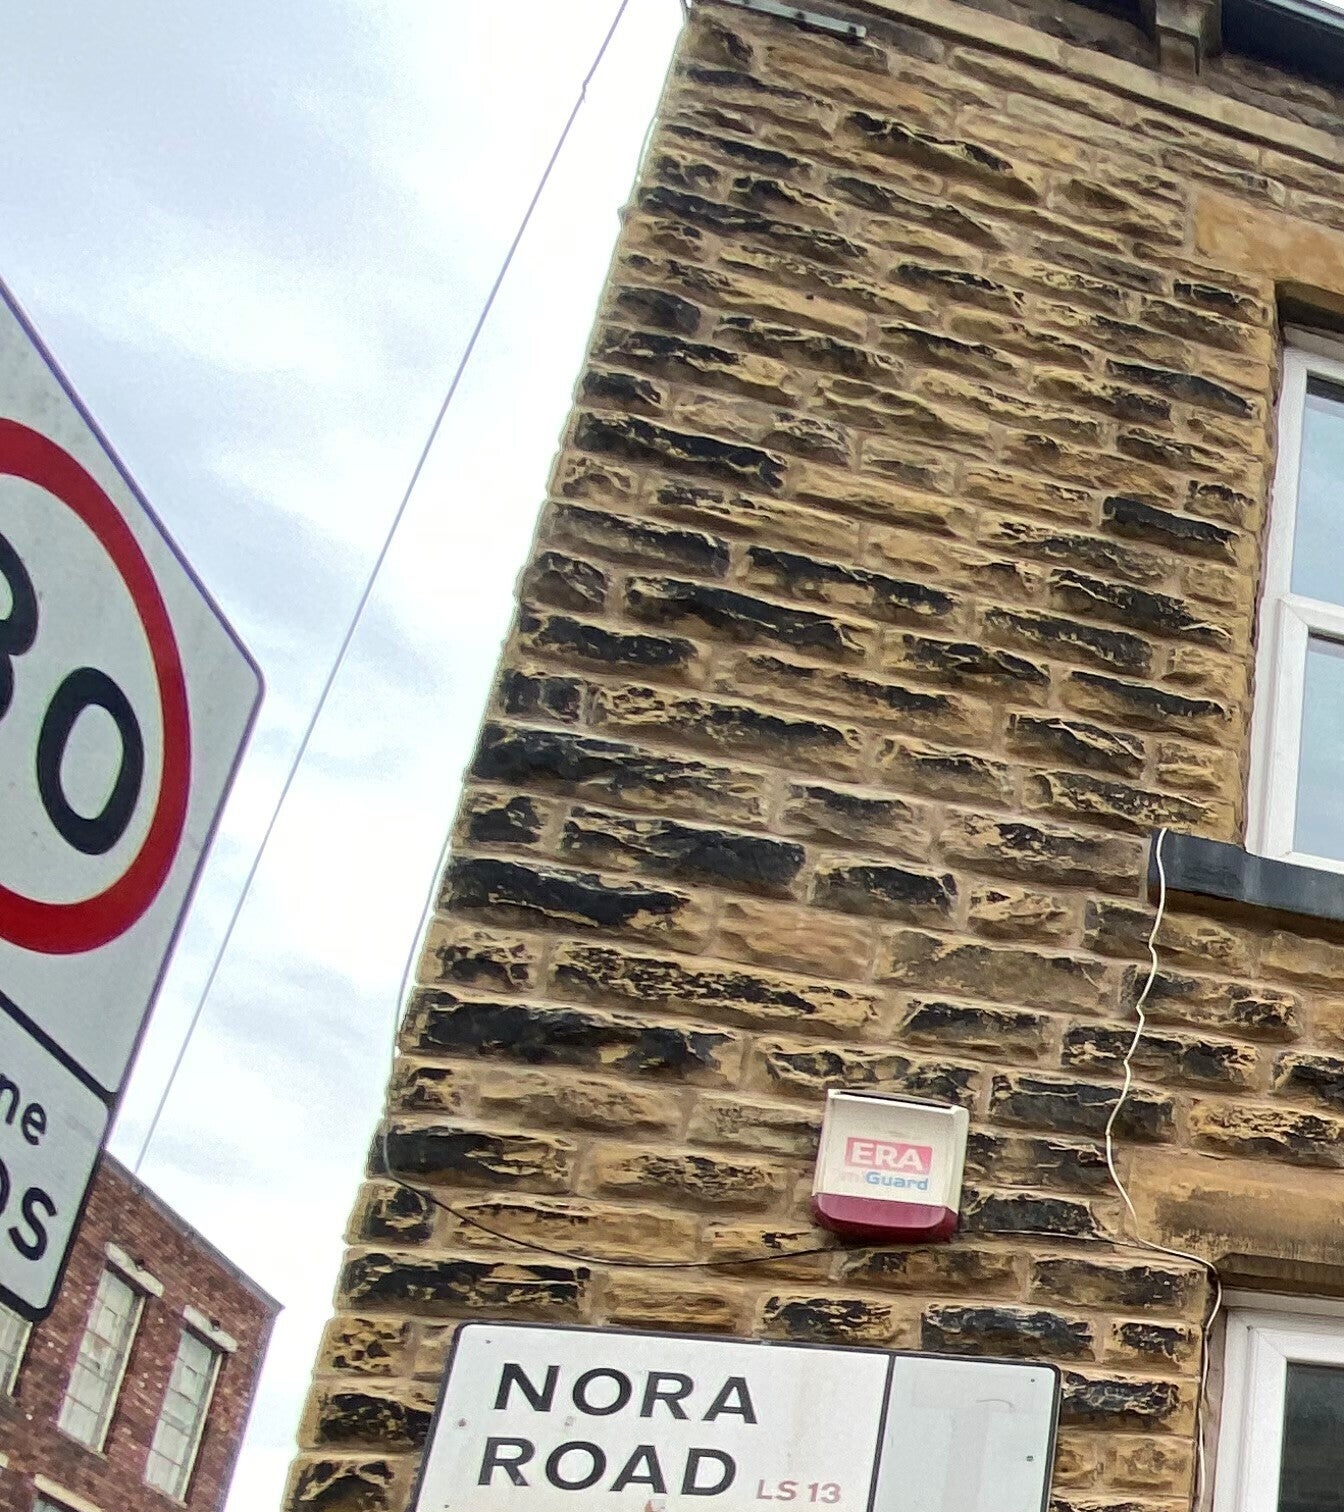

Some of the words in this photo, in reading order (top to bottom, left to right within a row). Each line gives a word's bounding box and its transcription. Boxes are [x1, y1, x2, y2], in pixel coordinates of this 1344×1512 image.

[851, 1141, 923, 1171] ERA
[865, 1171, 929, 1191] Guard
[494, 1363, 757, 1424] NORA
[478, 1437, 736, 1496] ROAD
[757, 1479, 798, 1501] LS
[808, 1482, 841, 1504] 13
